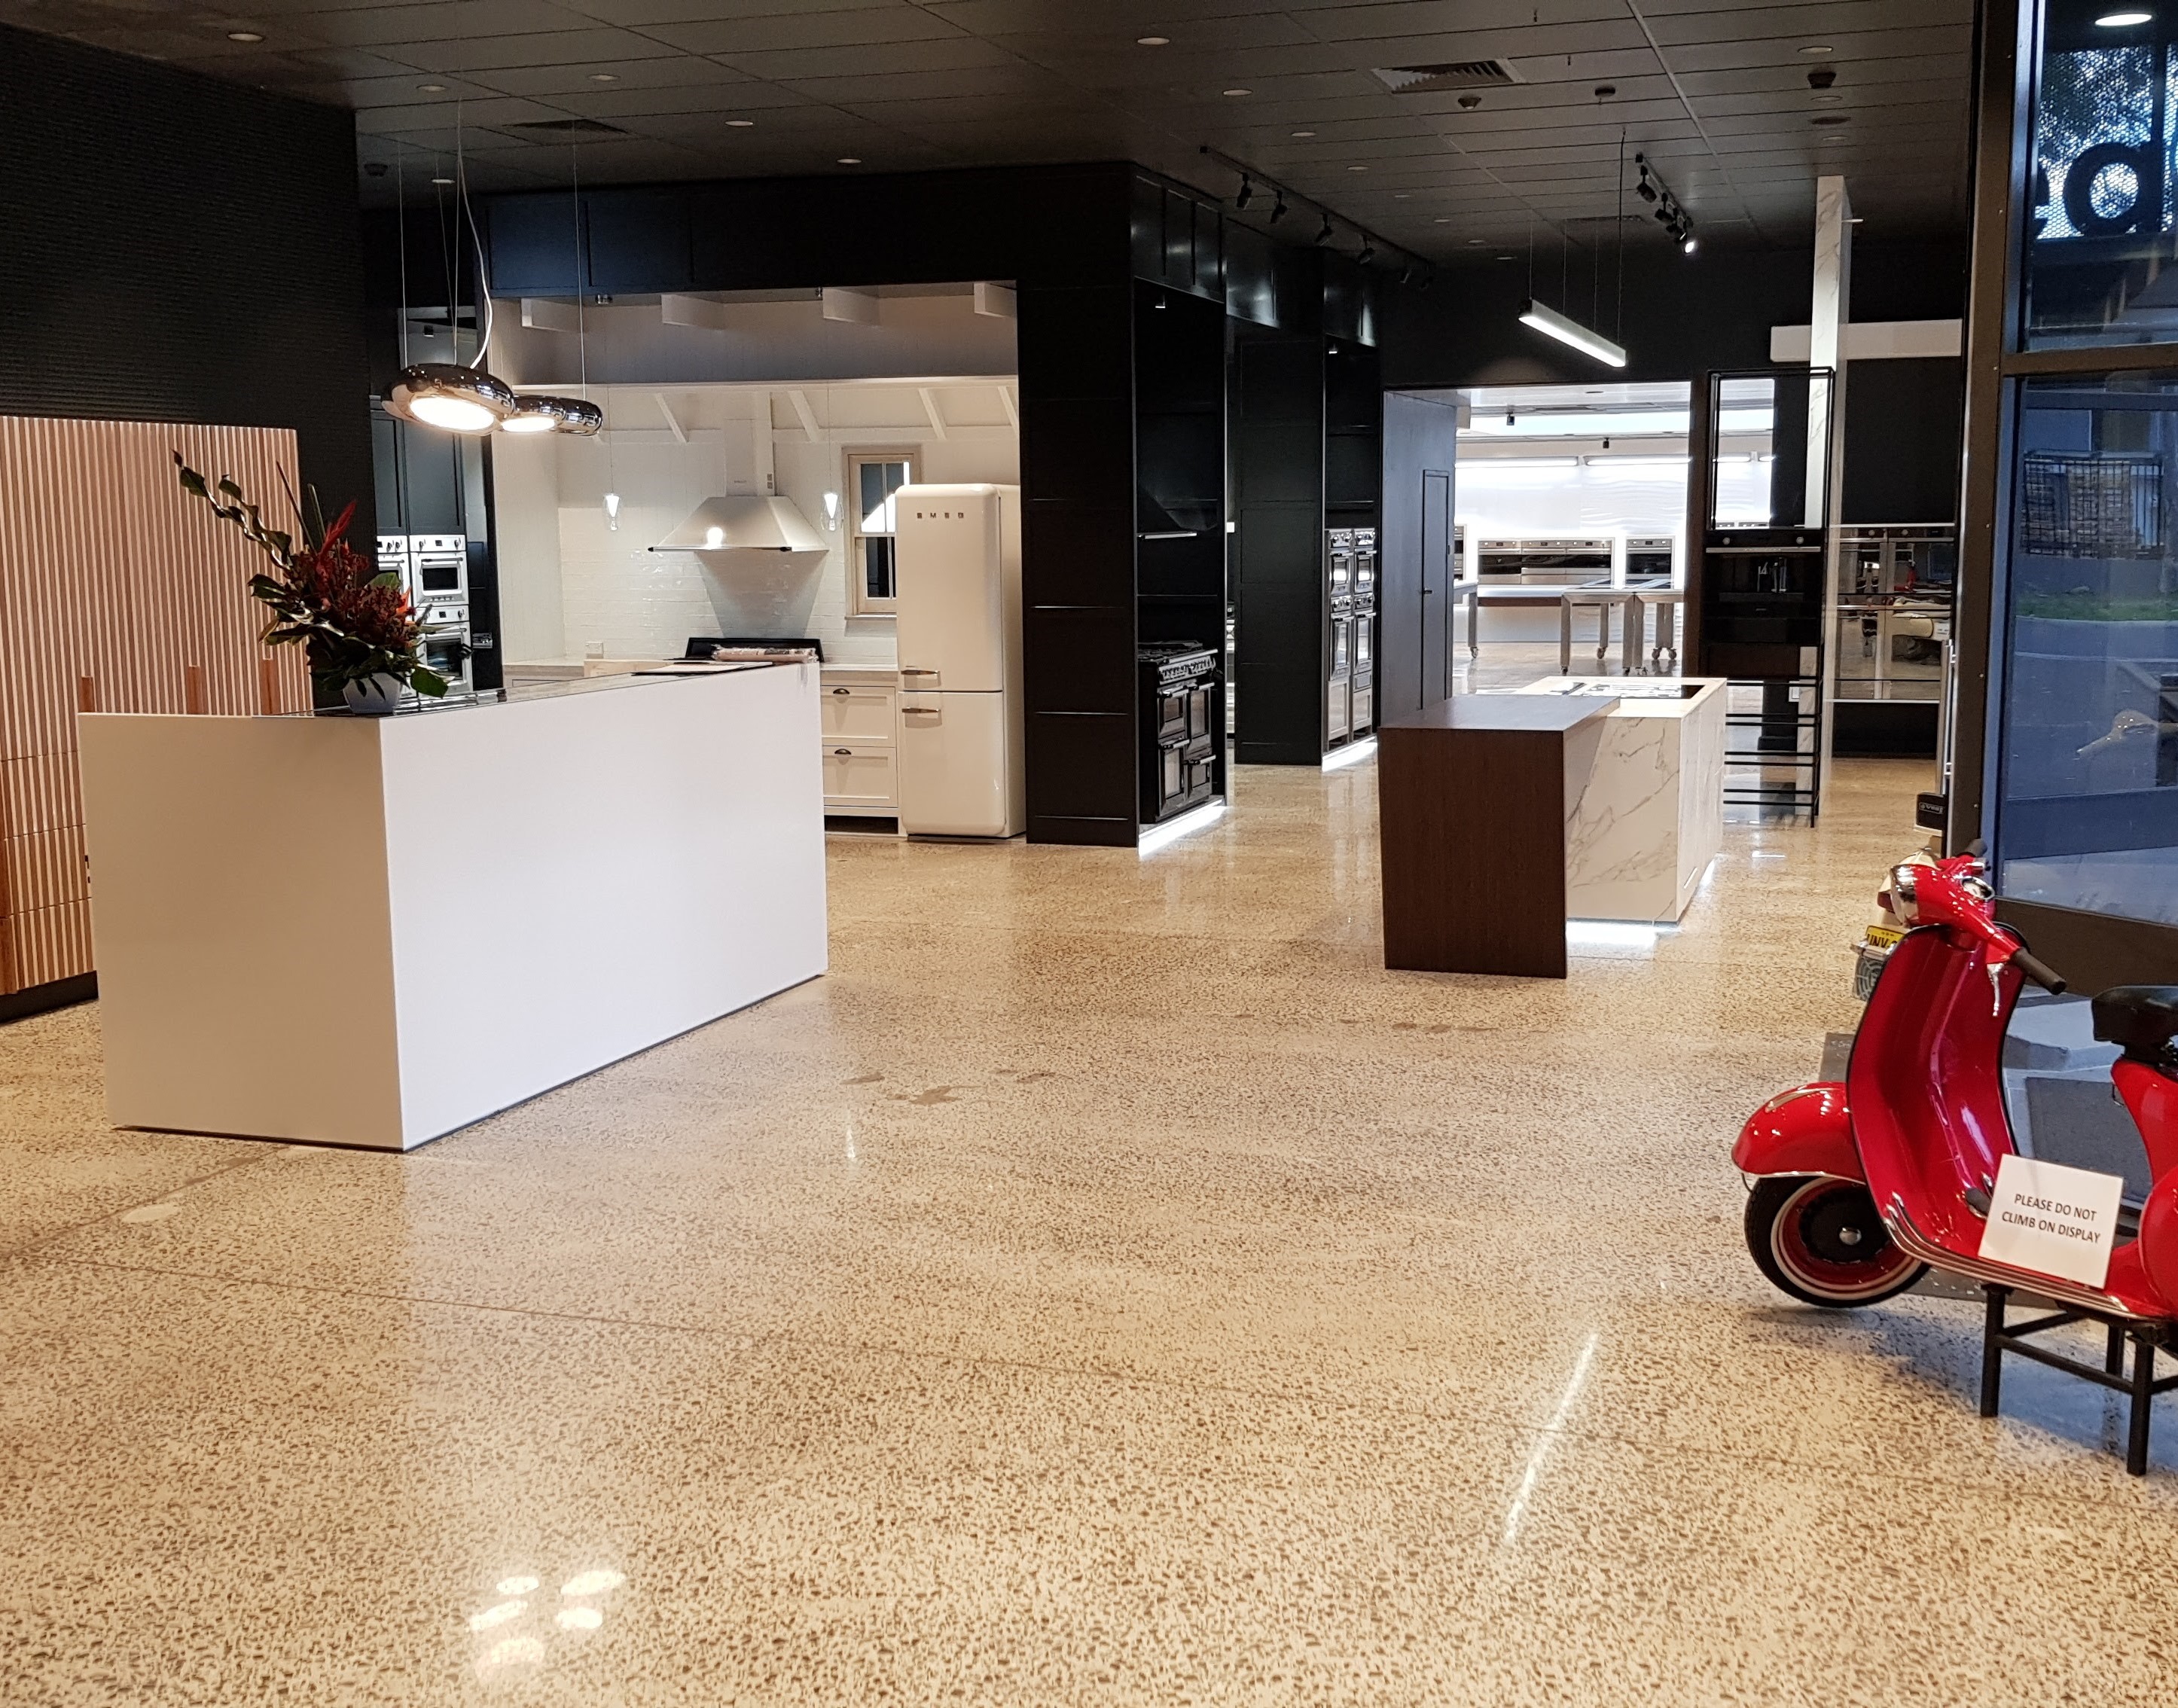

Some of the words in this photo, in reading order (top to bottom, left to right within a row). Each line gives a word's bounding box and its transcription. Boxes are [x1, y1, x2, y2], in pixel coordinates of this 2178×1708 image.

[2014, 1193, 2053, 1212] PLEASE
[2054, 1203, 2072, 1215] DO
[2073, 1207, 2097, 1222] NOT
[2002, 1211, 2036, 1228] CLIMB
[2038, 1219, 2056, 1233] ON
[2058, 1224, 2101, 1244] DISPLAY
